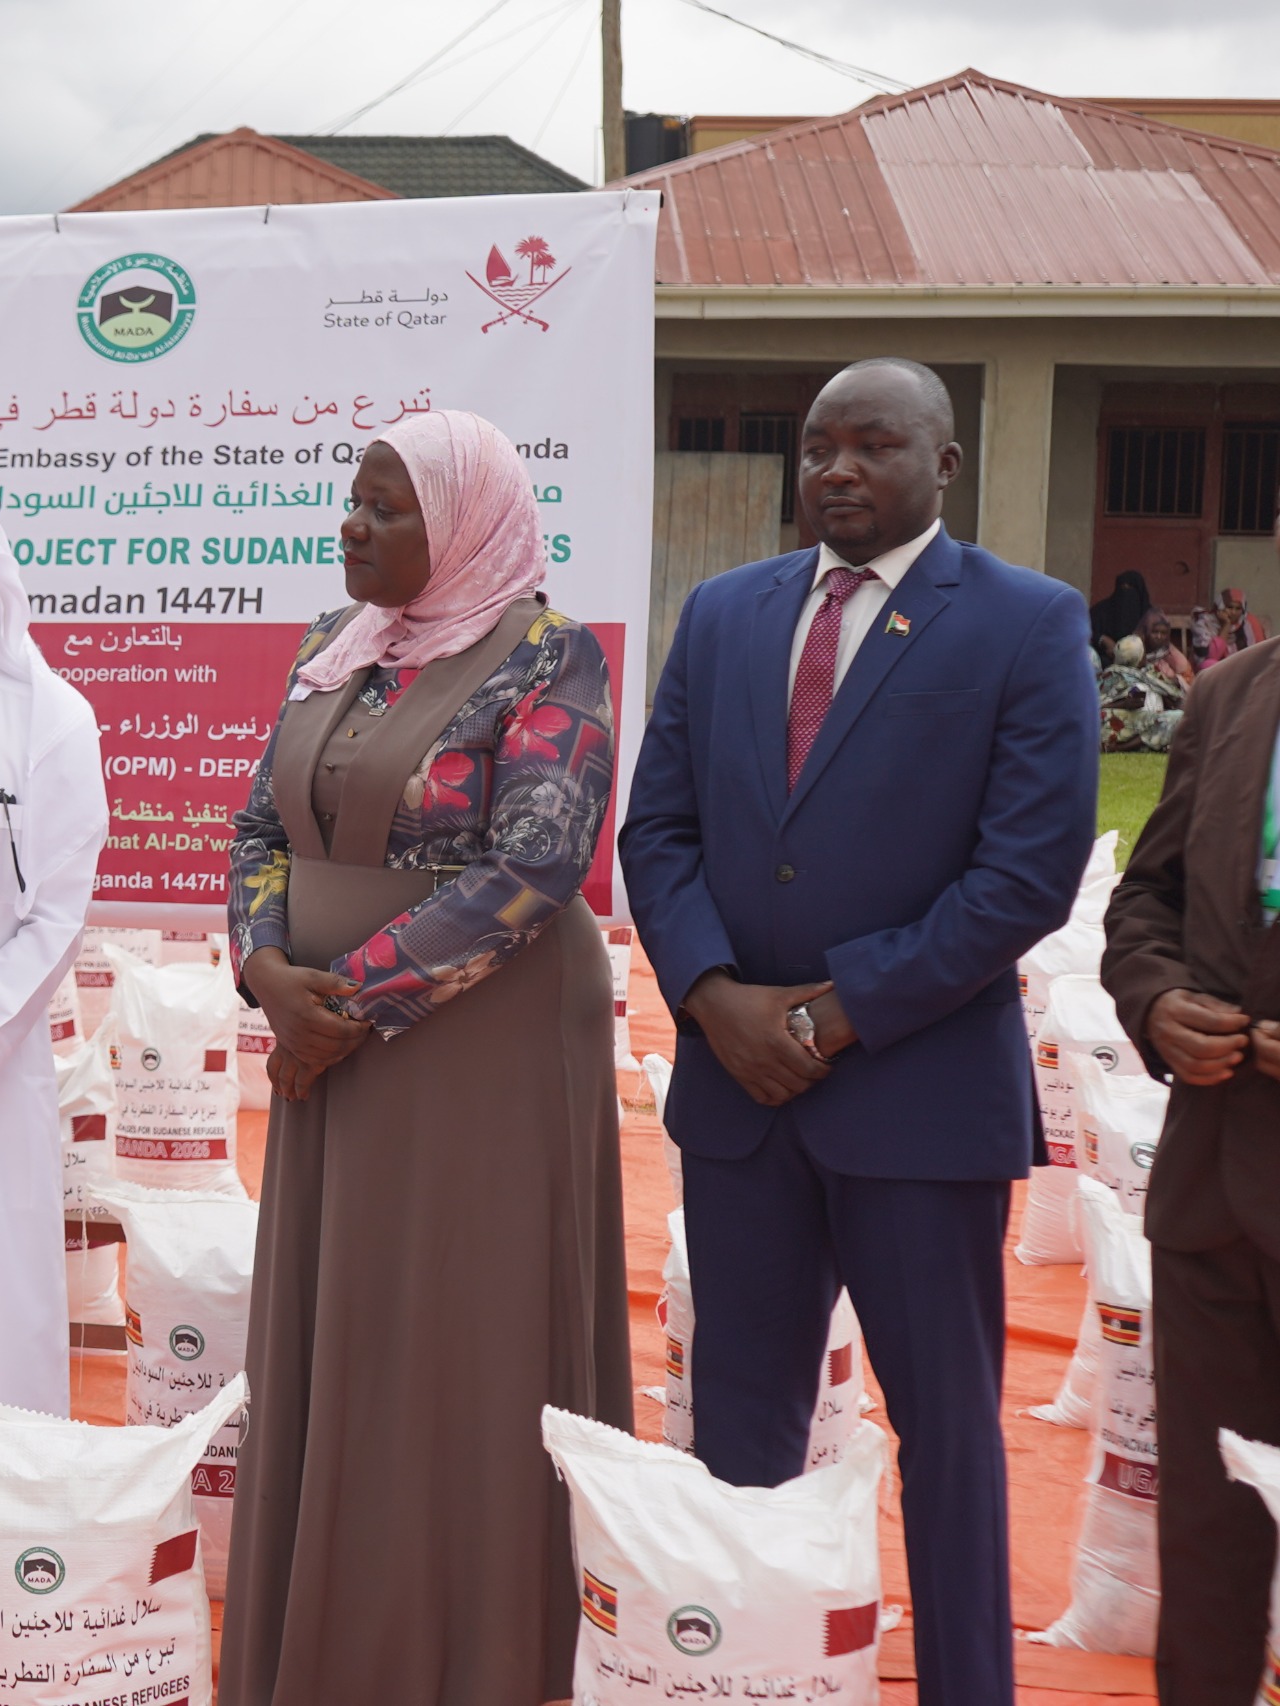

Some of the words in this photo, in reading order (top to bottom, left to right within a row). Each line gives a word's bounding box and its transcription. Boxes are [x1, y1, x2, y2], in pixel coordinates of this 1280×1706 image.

[113, 327, 154, 337] MADA
[323, 312, 370, 329] State
[374, 310, 394, 327] of
[397, 310, 448, 330] Qatar
[32, 391, 97, 431] قطر
[109, 390, 176, 429] دولة
[189, 389, 279, 427] سفارة
[292, 395, 339, 425] من
[126, 445, 154, 467] of
[161, 445, 204, 466] the
[213, 444, 285, 466] State
[294, 442, 323, 465] of
[515, 437, 570, 459] nda
[105, 481, 204, 516] للاجئين
[213, 480, 333, 515] الغذائية
[9, 537, 117, 567] OJECT
[127, 536, 191, 565] FOR
[201, 536, 346, 566] SUDANE
[28, 585, 146, 615] madan
[156, 586, 264, 615] 1447H
[63, 631, 94, 656] مع
[99, 624, 183, 653] بالتعاون
[174, 664, 218, 684] with
[119, 711, 200, 741] الوزراء
[207, 716, 272, 742] رئيس
[104, 755, 177, 781] (OPM)
[111, 797, 175, 823] منظمة
[183, 800, 236, 829] تنفيذ
[92, 871, 153, 892] ganda
[160, 872, 225, 891] 1447H
[170, 1141, 211, 1159] 2026
[27, 1575, 52, 1584] MADA
[11, 1610, 74, 1638] للاجئين
[83, 1605, 126, 1637] غذائية
[131, 1597, 163, 1626] سلال
[63, 1653, 117, 1687] السفارة
[123, 1652, 139, 1677] من
[146, 1637, 177, 1675] تبرع
[131, 1674, 191, 1706] REFUGEES
